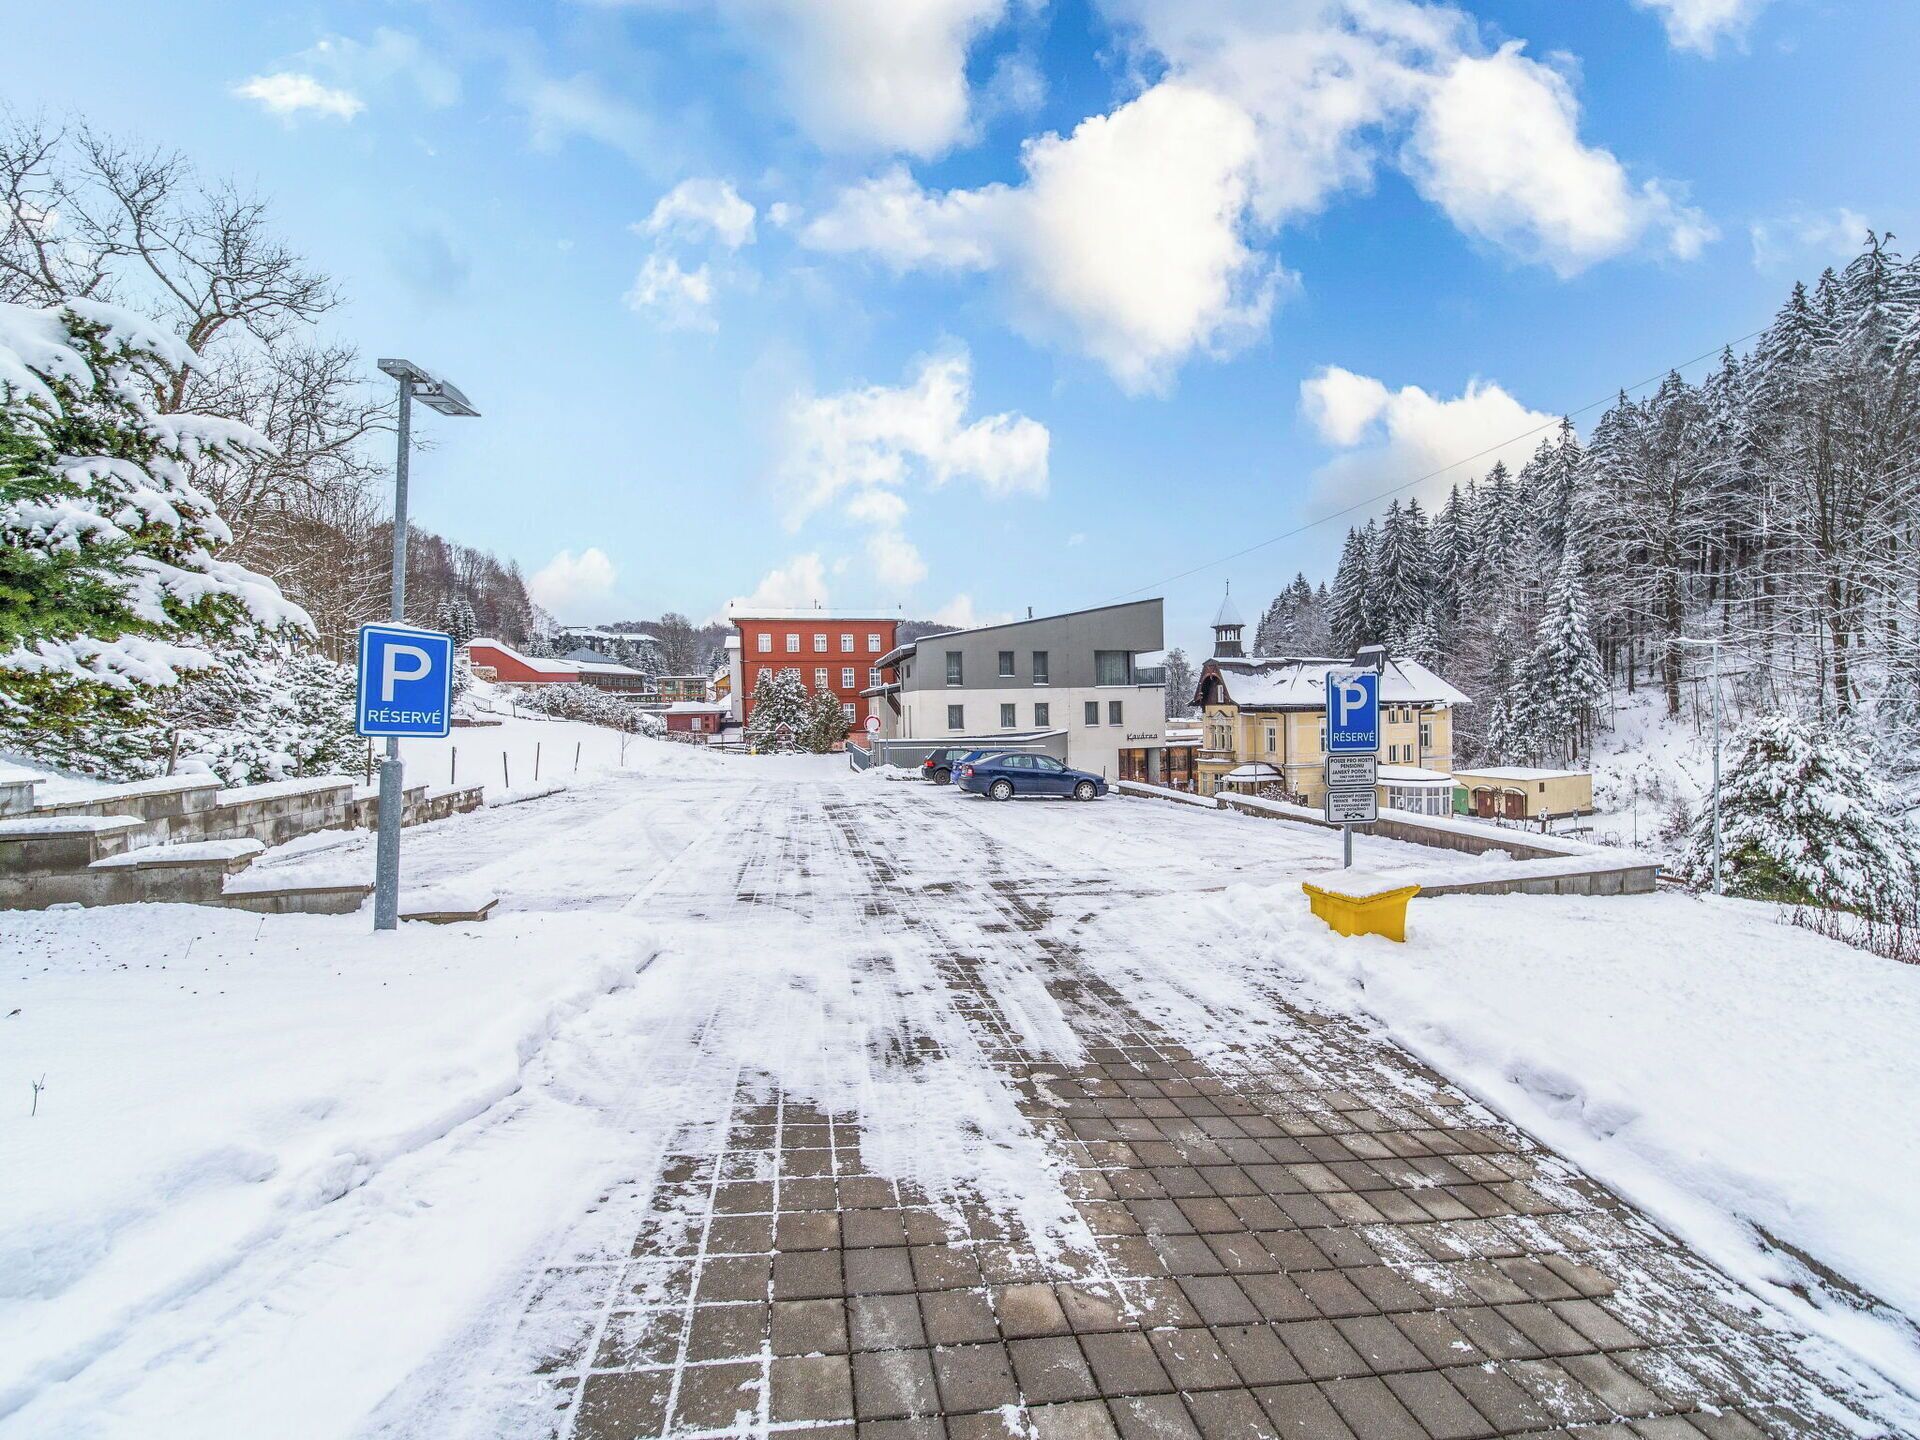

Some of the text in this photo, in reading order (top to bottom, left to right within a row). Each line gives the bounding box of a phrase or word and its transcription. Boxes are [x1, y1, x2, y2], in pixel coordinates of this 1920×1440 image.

[382, 643, 432, 702] P
[368, 707, 441, 724] RÉSERVÉ
[1340, 682, 1368, 726] P
[1333, 730, 1375, 742] RÉSERVÉ
